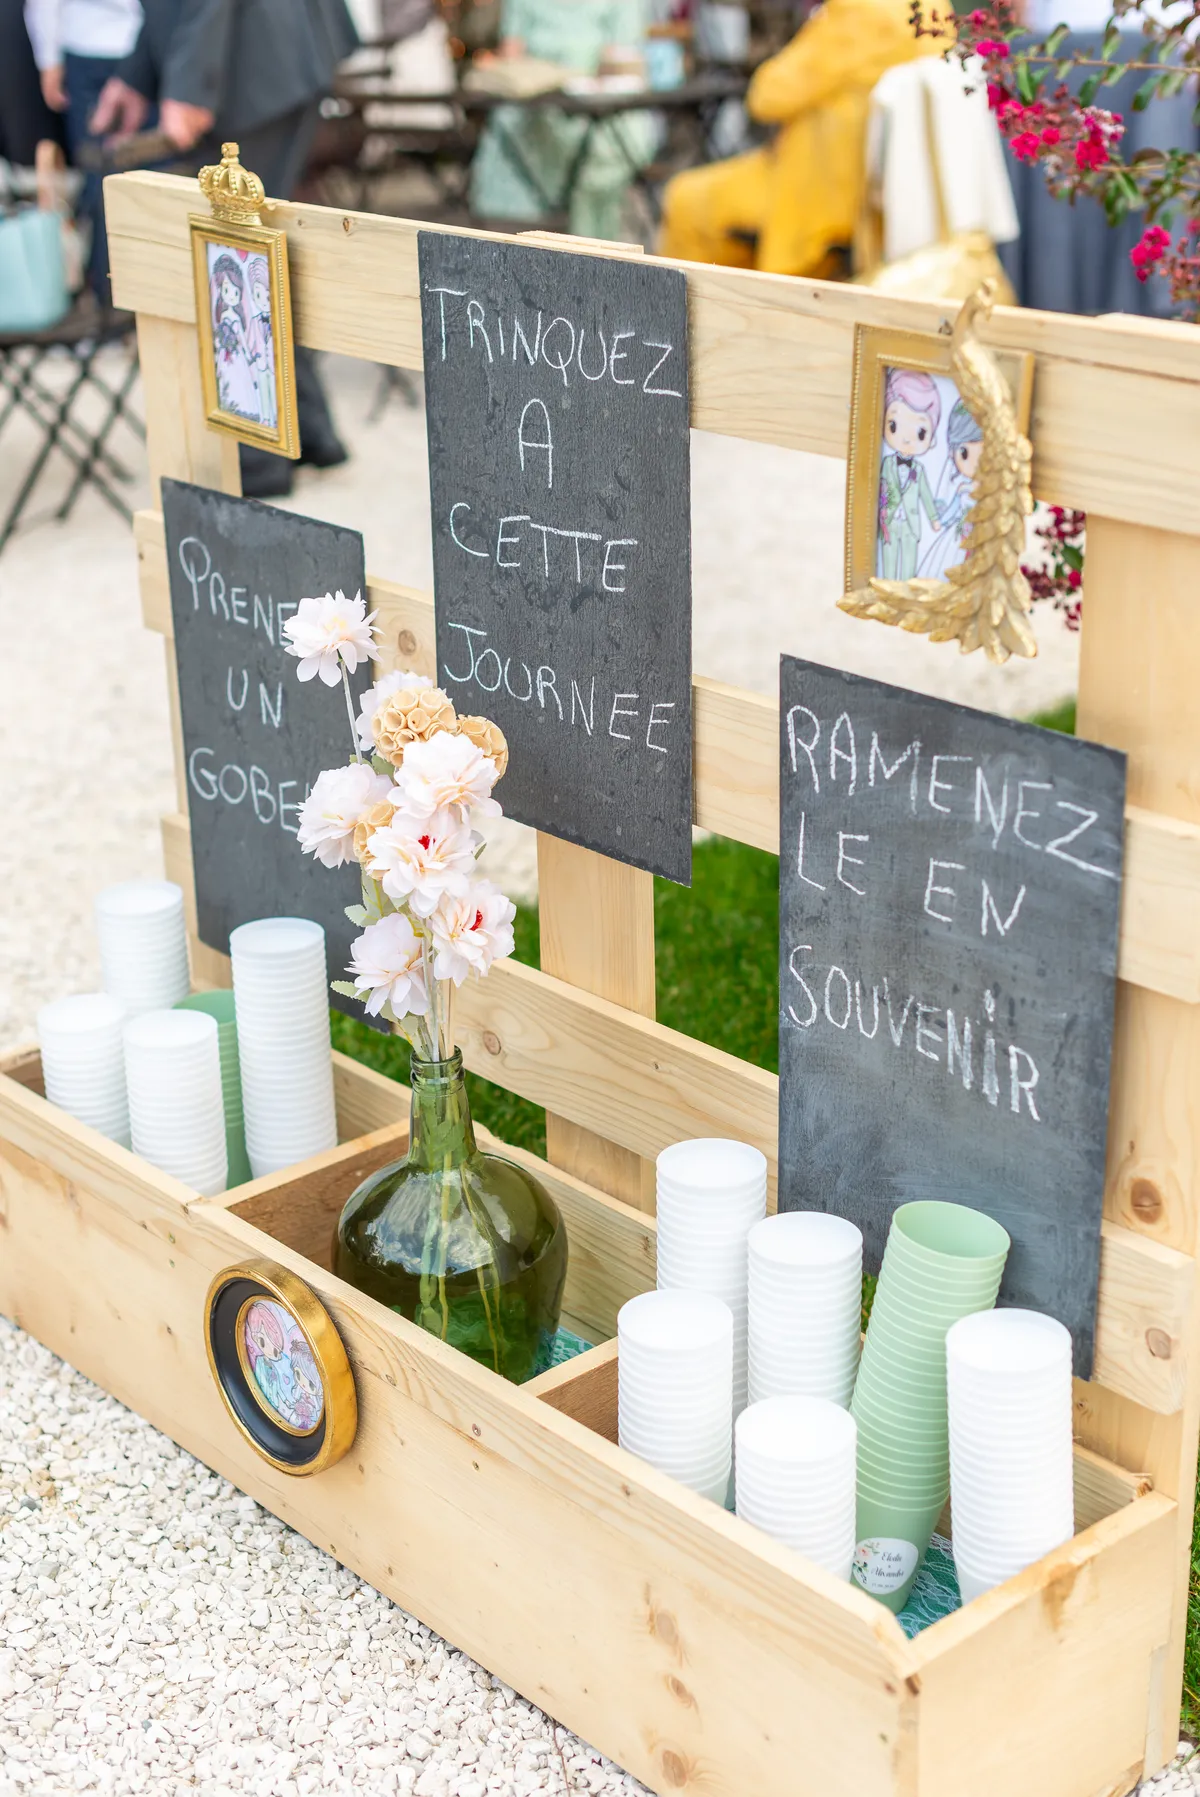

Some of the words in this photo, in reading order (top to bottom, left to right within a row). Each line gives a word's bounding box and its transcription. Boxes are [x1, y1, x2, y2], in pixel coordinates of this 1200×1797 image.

[425, 286, 683, 398] TRINQUEZ
[518, 398, 554, 489] A
[178, 536, 298, 647] PRENE
[449, 502, 639, 593] CETTE
[226, 666, 283, 729] UN
[444, 621, 676, 753] JOURNEE
[188, 747, 310, 834] GOBE
[786, 704, 1122, 881] RAMENEZ
[798, 811, 870, 895] LE
[924, 857, 1027, 937] EN
